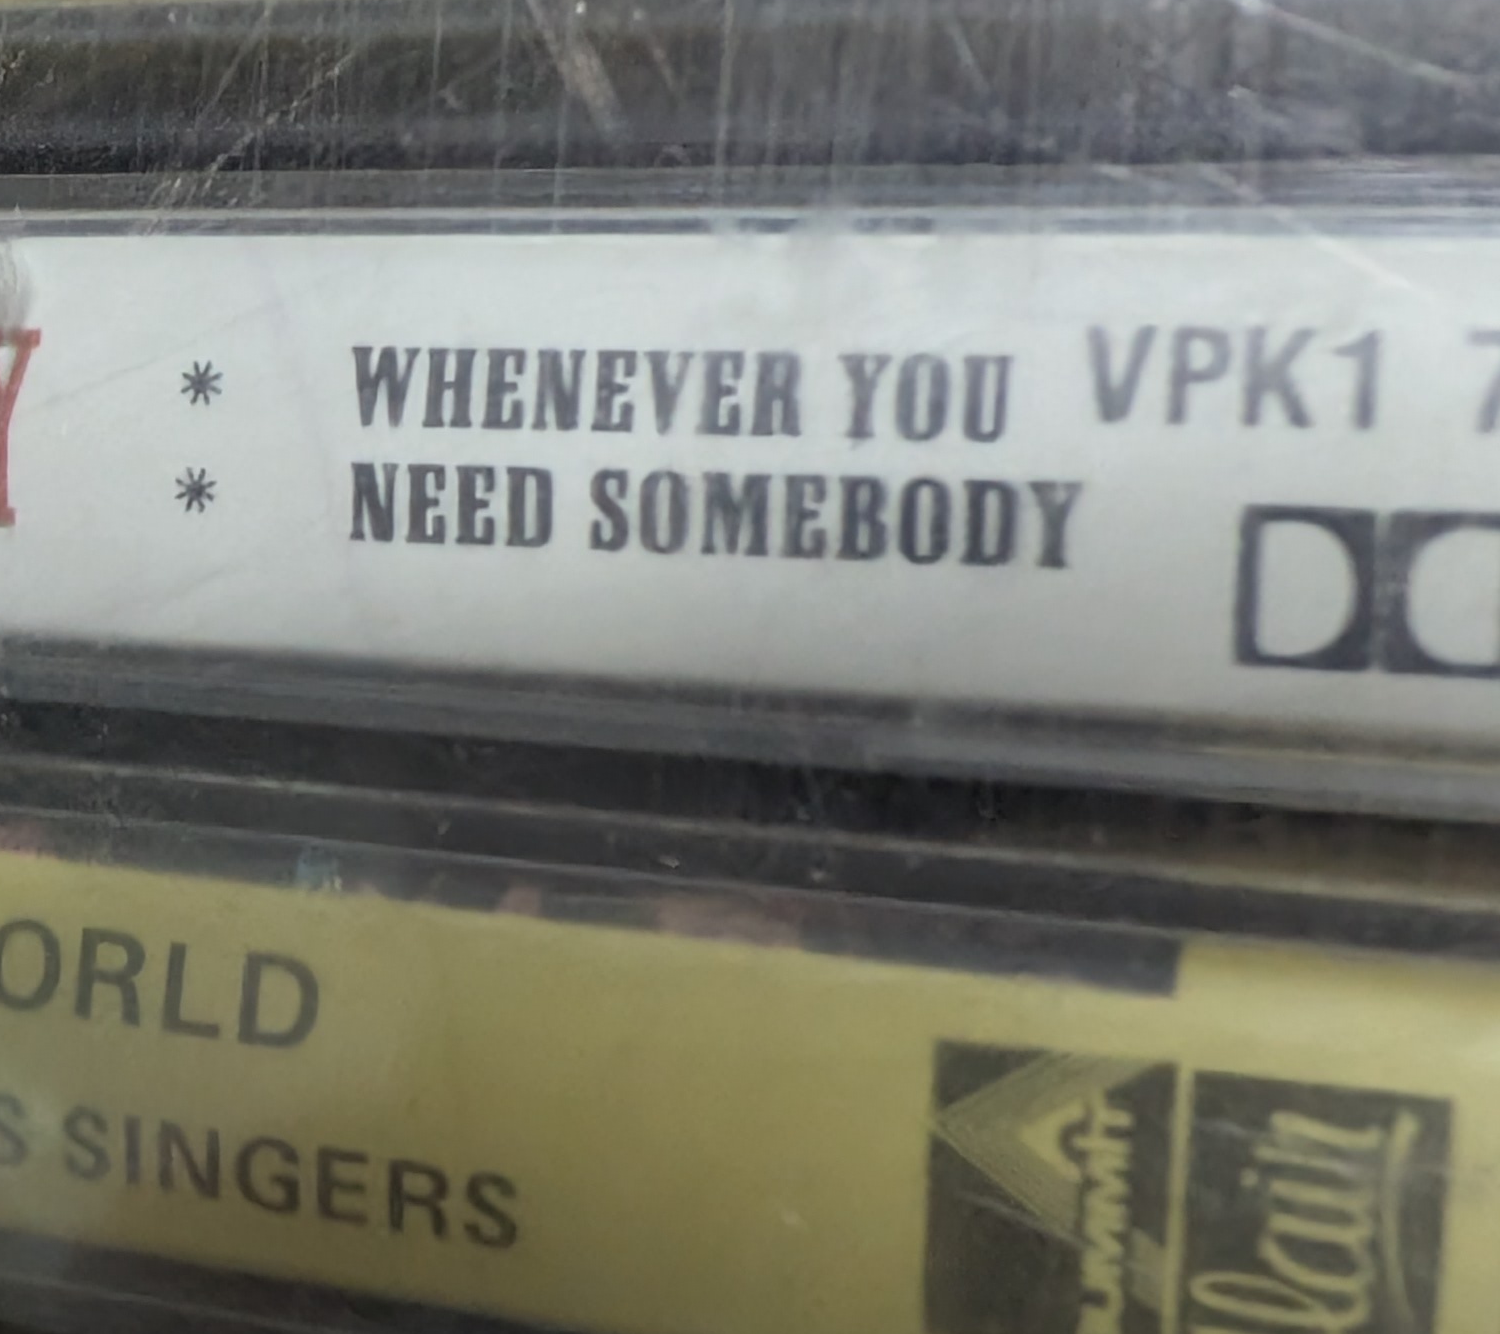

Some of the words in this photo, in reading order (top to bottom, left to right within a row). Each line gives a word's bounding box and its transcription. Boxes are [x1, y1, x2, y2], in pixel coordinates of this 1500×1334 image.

[351, 345, 805, 438] WHENEVER
[838, 353, 1016, 444] YOU
[1086, 323, 1387, 431] VPK1
[349, 461, 555, 550] NEED
[589, 468, 1084, 571] SOMEBODY
[61, 1104, 522, 1250] SINGERS
